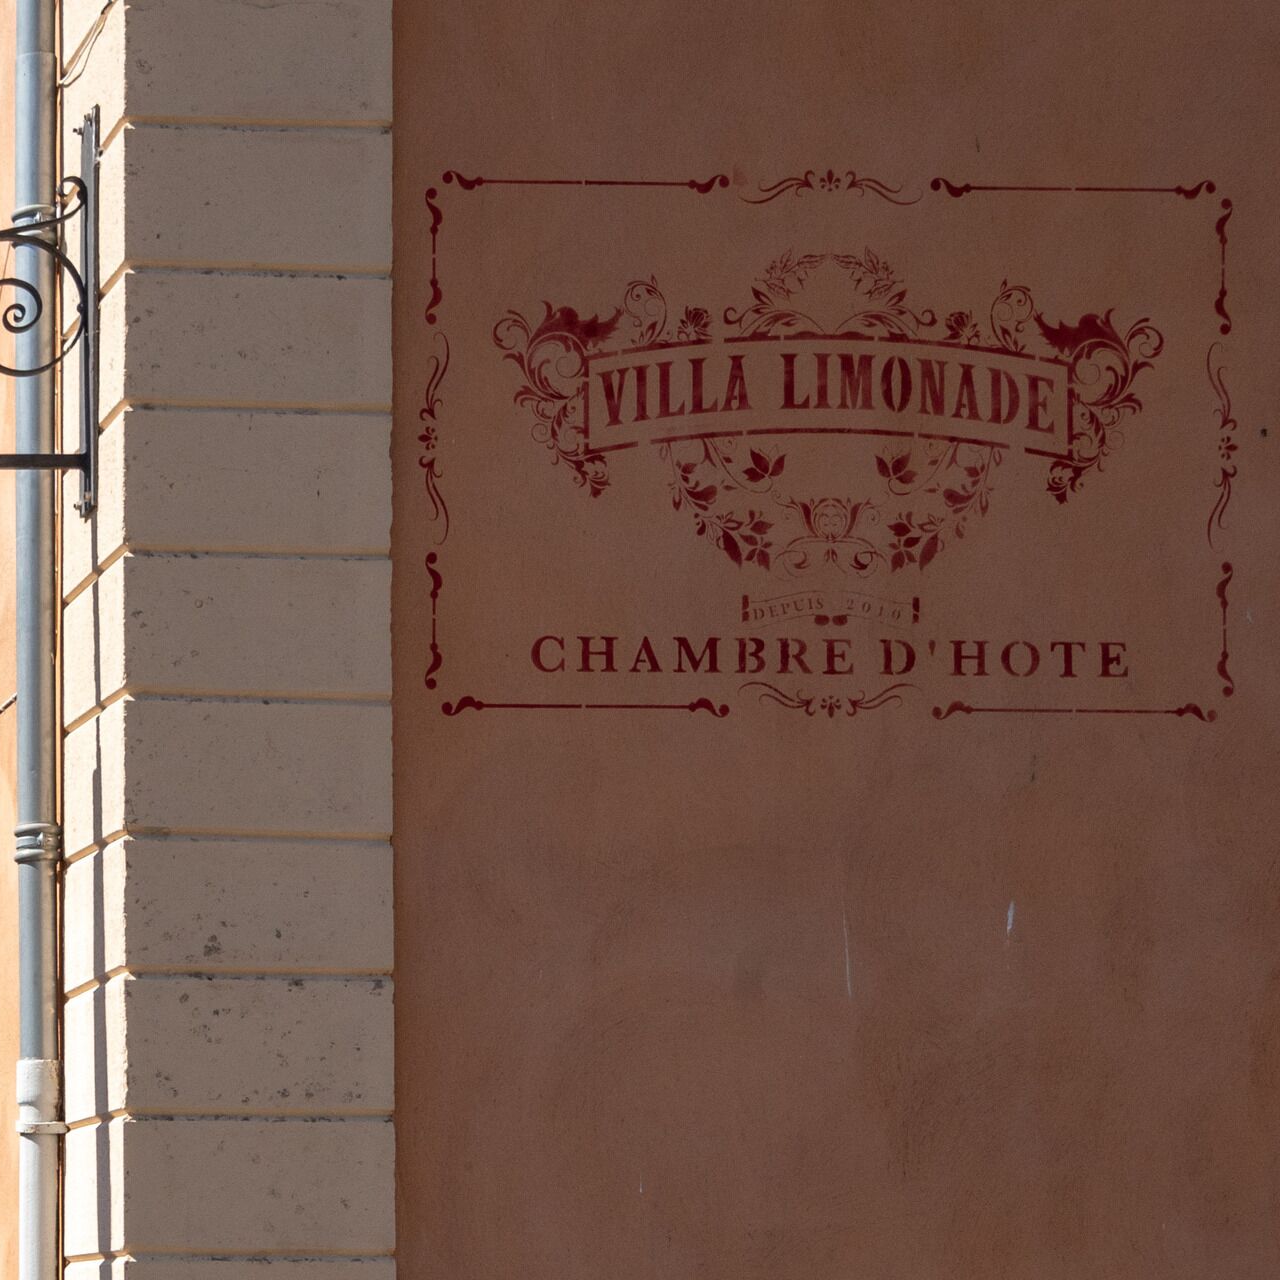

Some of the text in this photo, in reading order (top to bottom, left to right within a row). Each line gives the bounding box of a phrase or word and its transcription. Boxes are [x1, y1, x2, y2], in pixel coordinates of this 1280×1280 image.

[597, 353, 1056, 434] VILLA LIMONADE
[752, 598, 902, 621] DEPUIS 2010
[530, 635, 1130, 679] CHAMBRE D'HOTE
